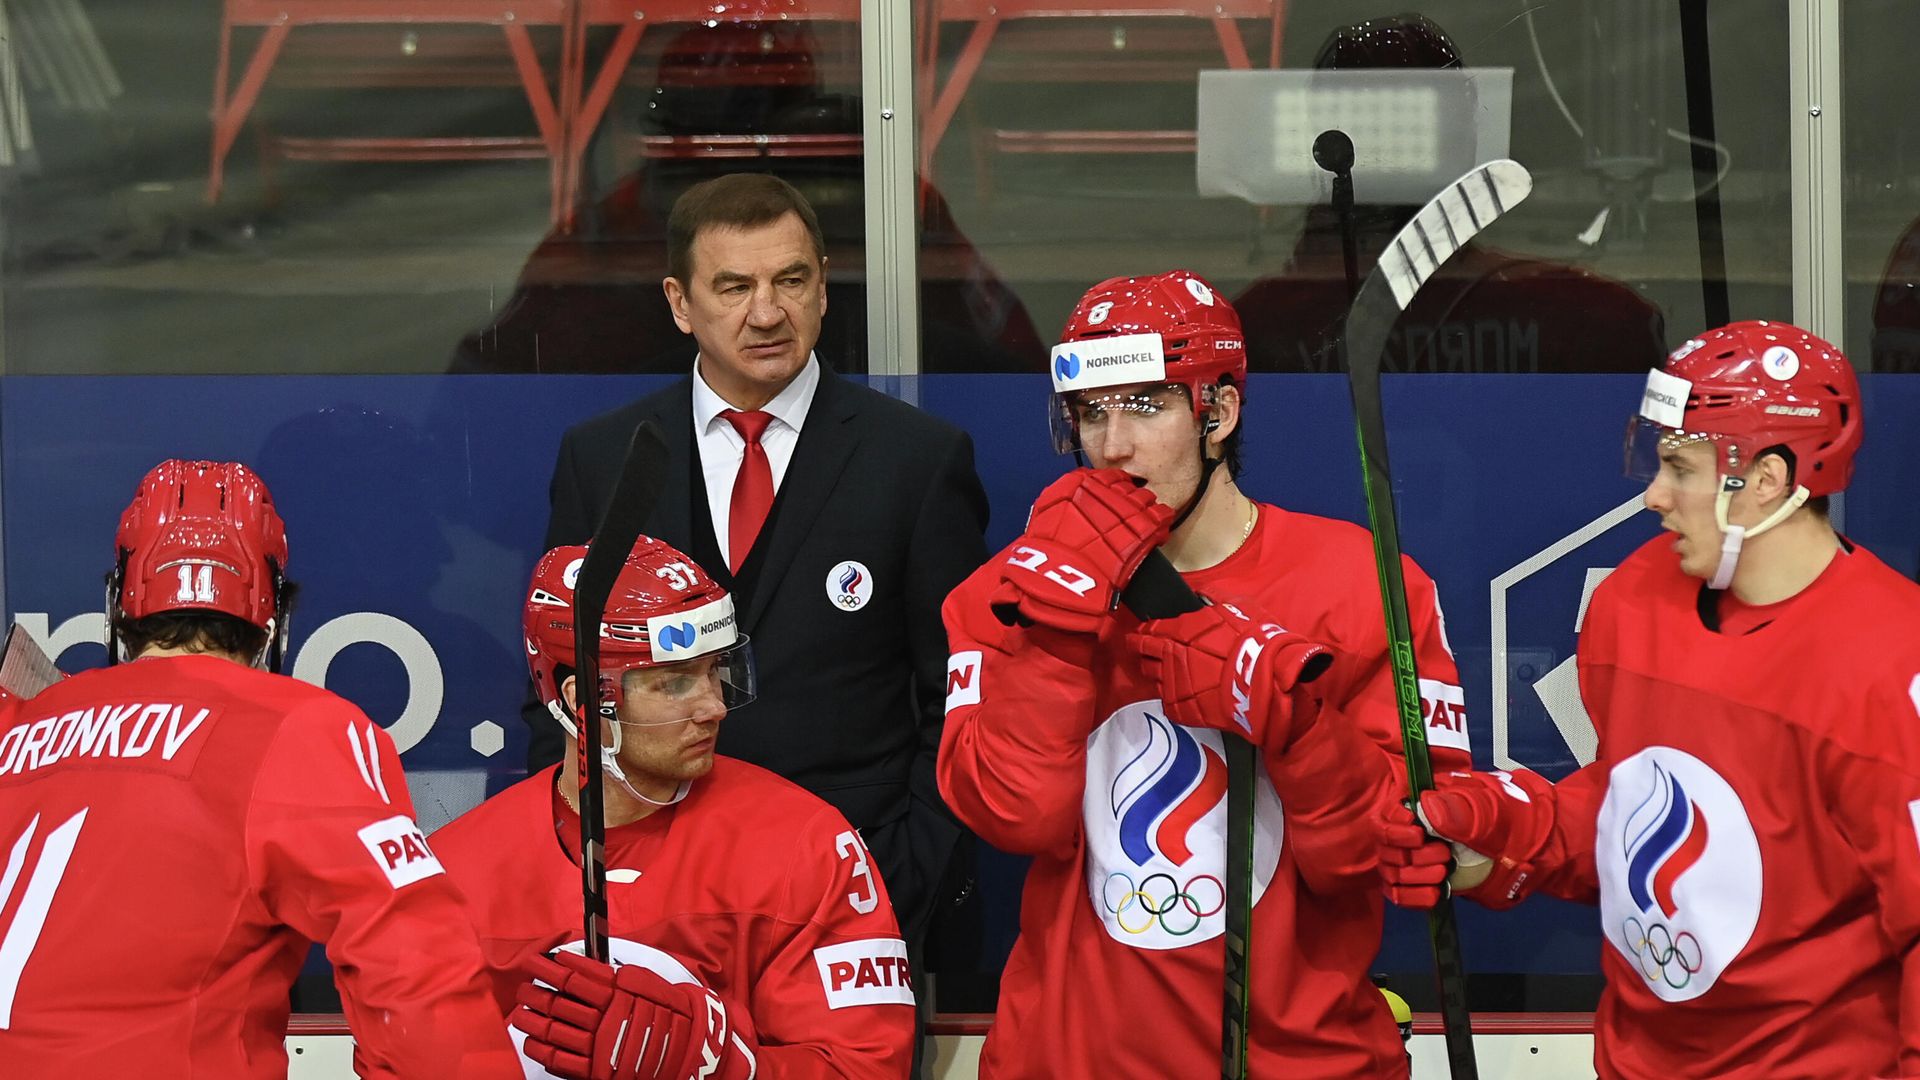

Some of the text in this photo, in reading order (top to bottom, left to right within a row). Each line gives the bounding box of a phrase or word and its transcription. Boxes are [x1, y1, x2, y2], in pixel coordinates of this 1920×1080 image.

[1215, 340, 1242, 350] CCM
[1086, 352, 1155, 369] NORNICKEL
[177, 565, 213, 601] 11
[656, 561, 698, 591] 37
